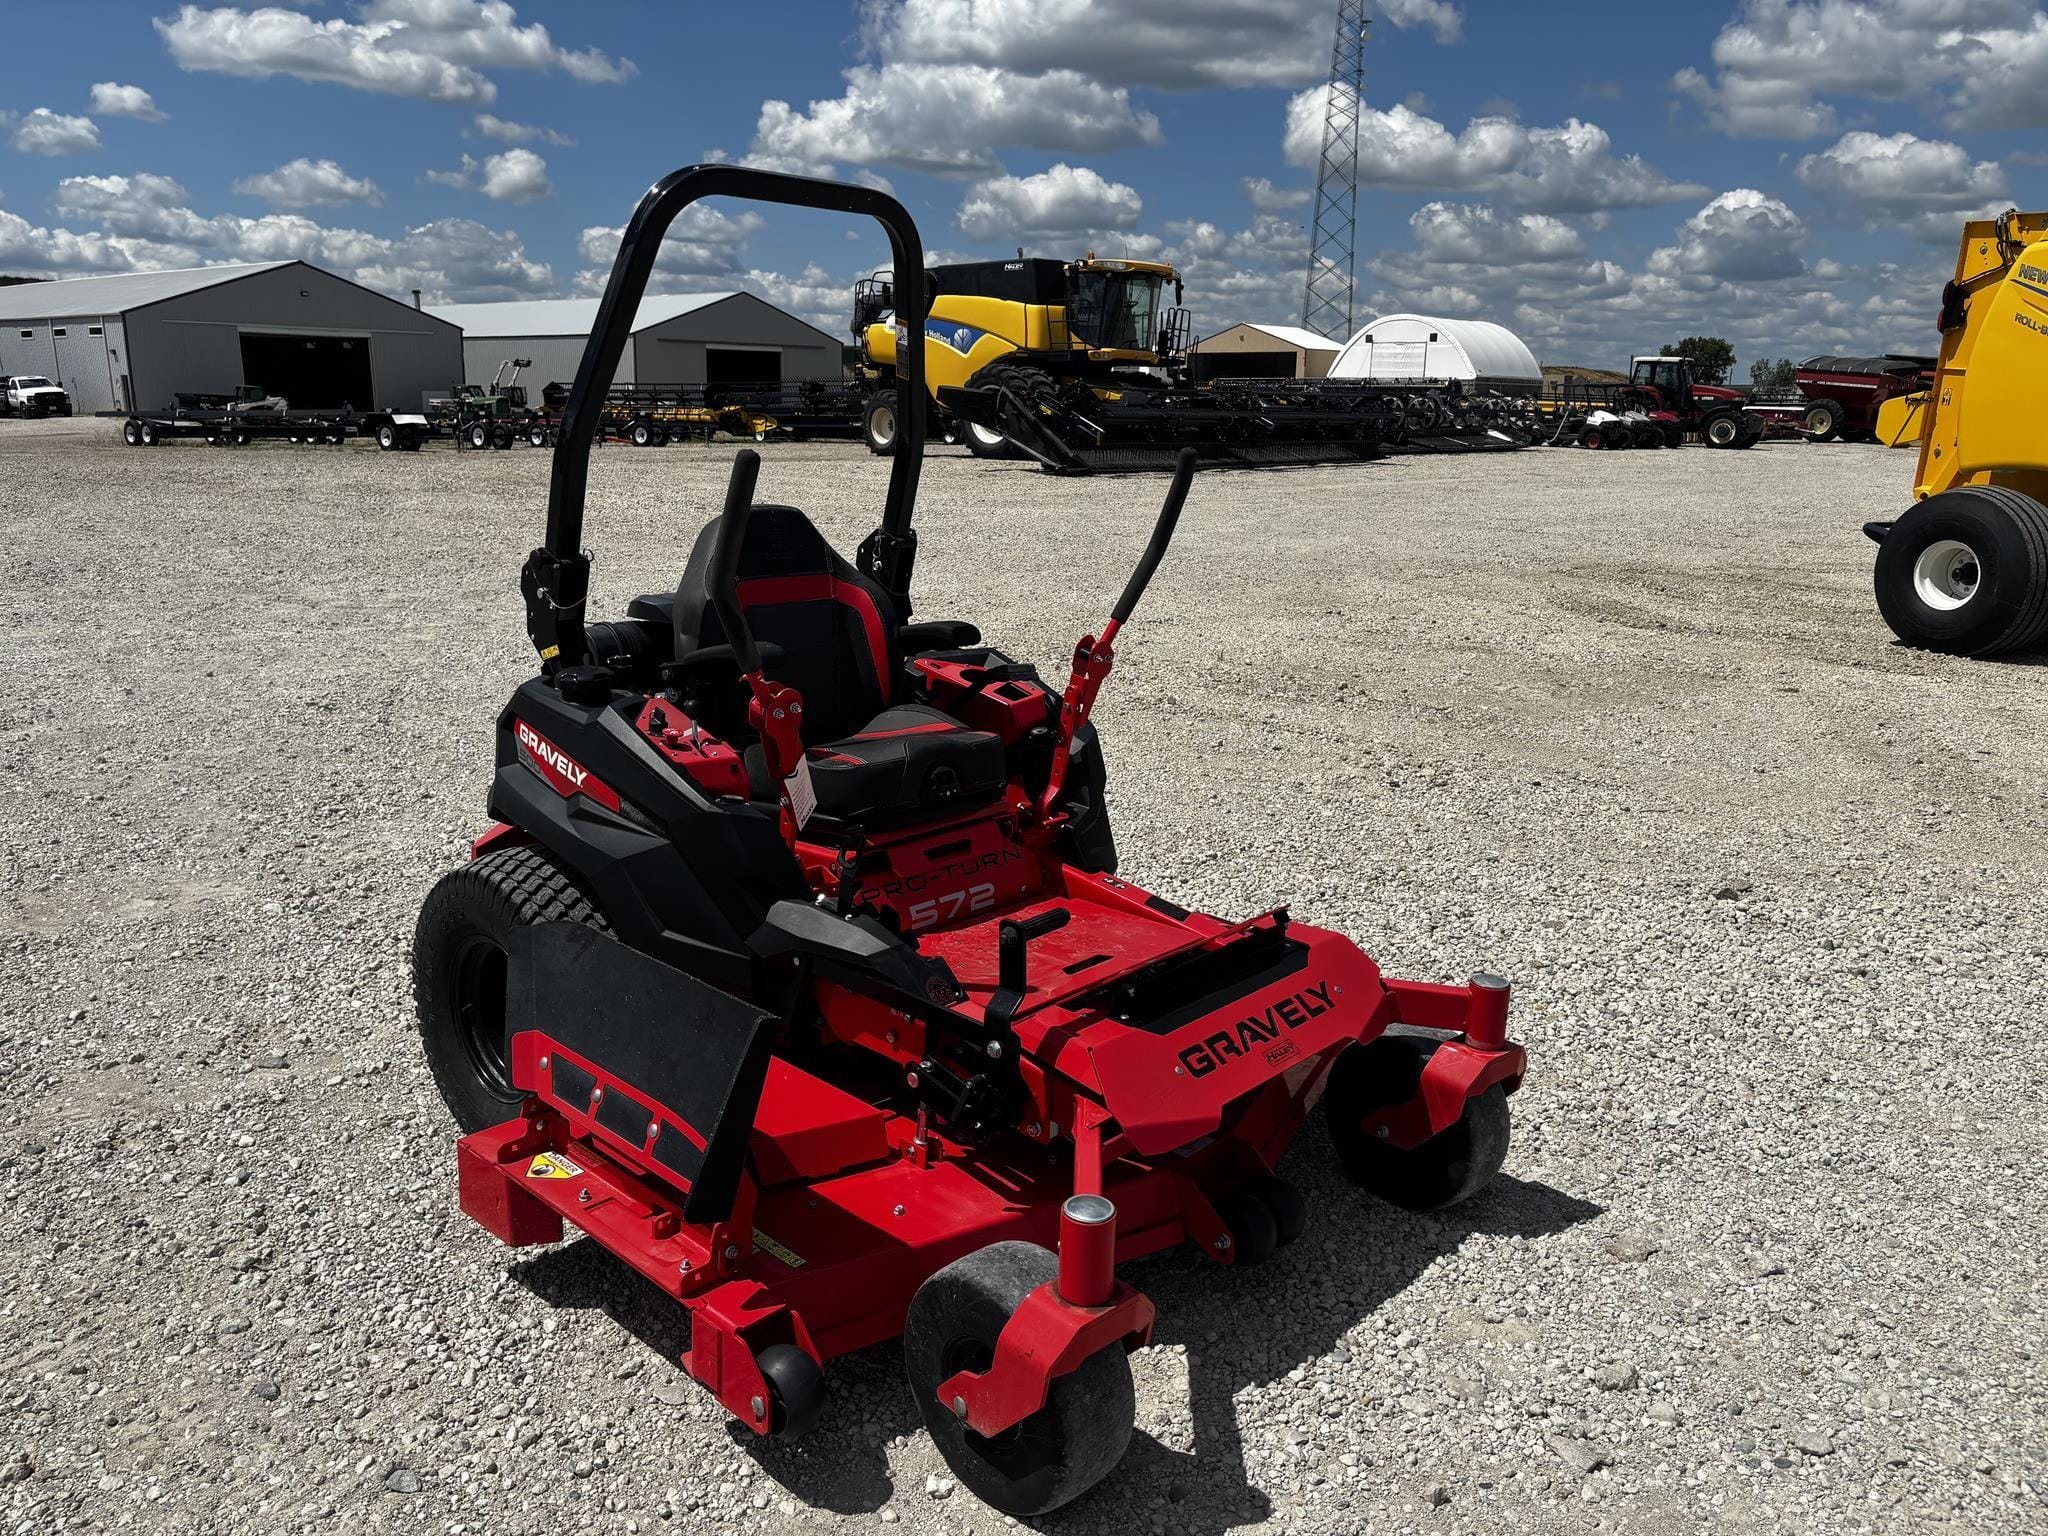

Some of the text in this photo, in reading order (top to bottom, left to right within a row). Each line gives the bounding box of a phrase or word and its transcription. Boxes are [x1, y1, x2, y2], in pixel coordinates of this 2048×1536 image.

[928, 328, 951, 345] Holland
[2015, 313, 2048, 336] ROLL-B
[518, 722, 588, 787] GRAVELY
[862, 846, 1023, 905] PRO-TURN
[910, 882, 996, 930] 572
[1178, 980, 1336, 1079] GRAVELY
[548, 1151, 579, 1174] DANGER
